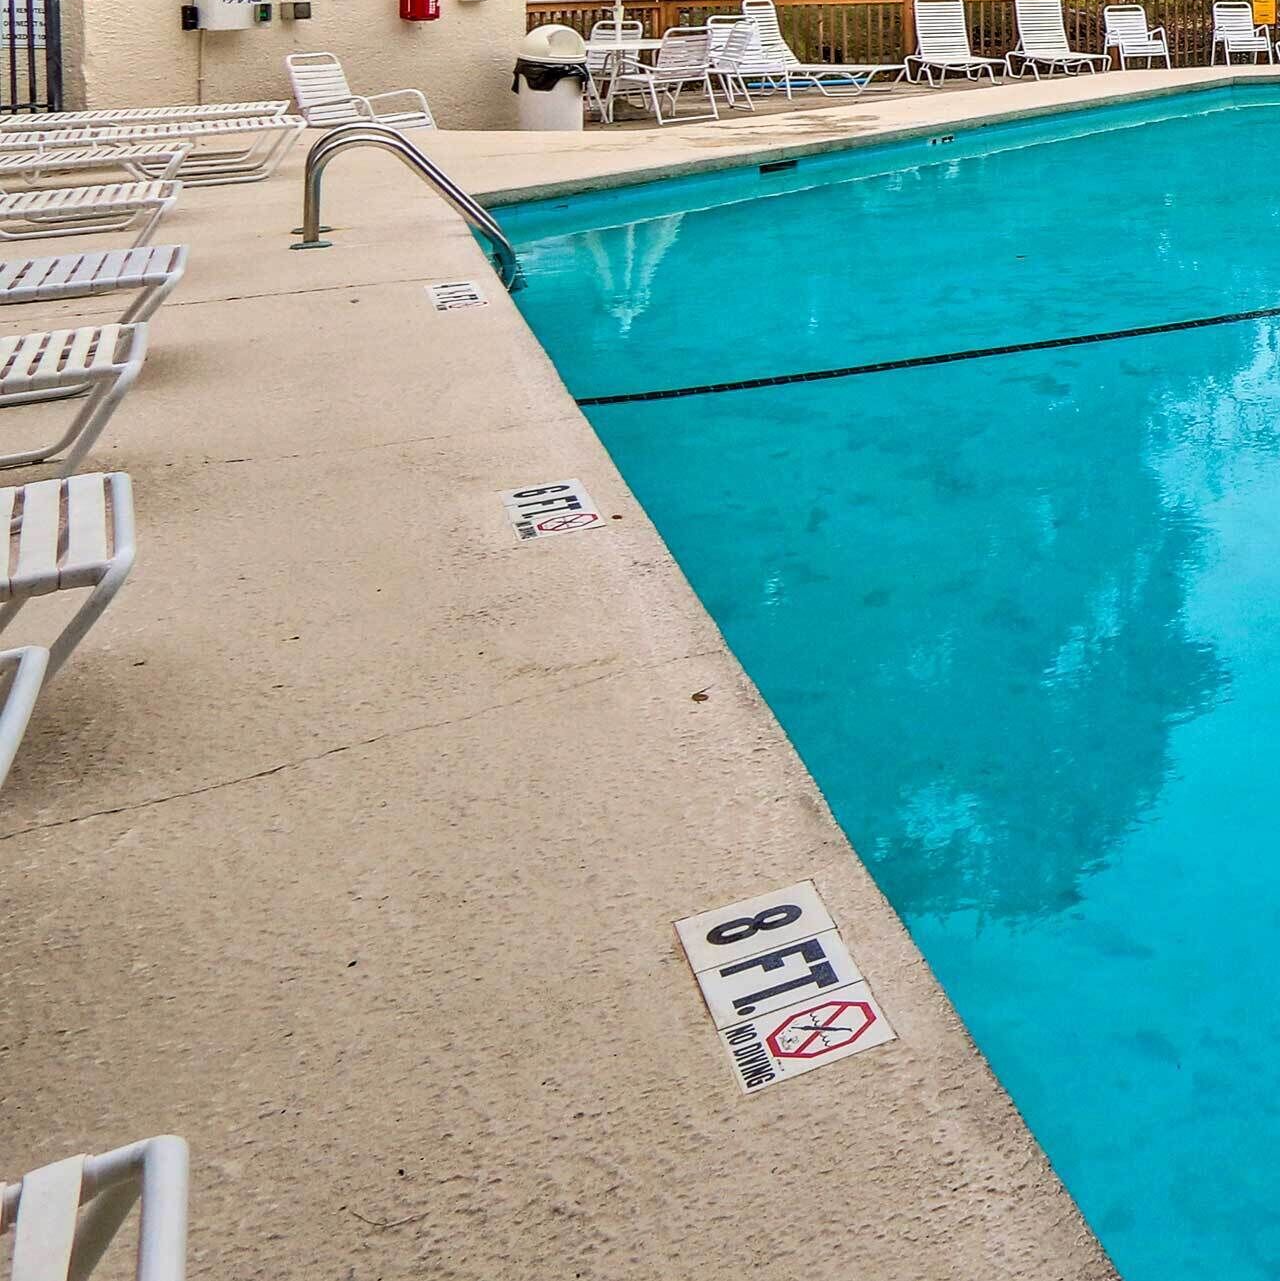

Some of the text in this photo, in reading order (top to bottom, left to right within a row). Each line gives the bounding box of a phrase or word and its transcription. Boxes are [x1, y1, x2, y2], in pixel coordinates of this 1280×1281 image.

[512, 484, 583, 520] 6 FT.
[706, 904, 840, 1017] 8 FT.
[725, 1023, 776, 1089] NO DIVING
